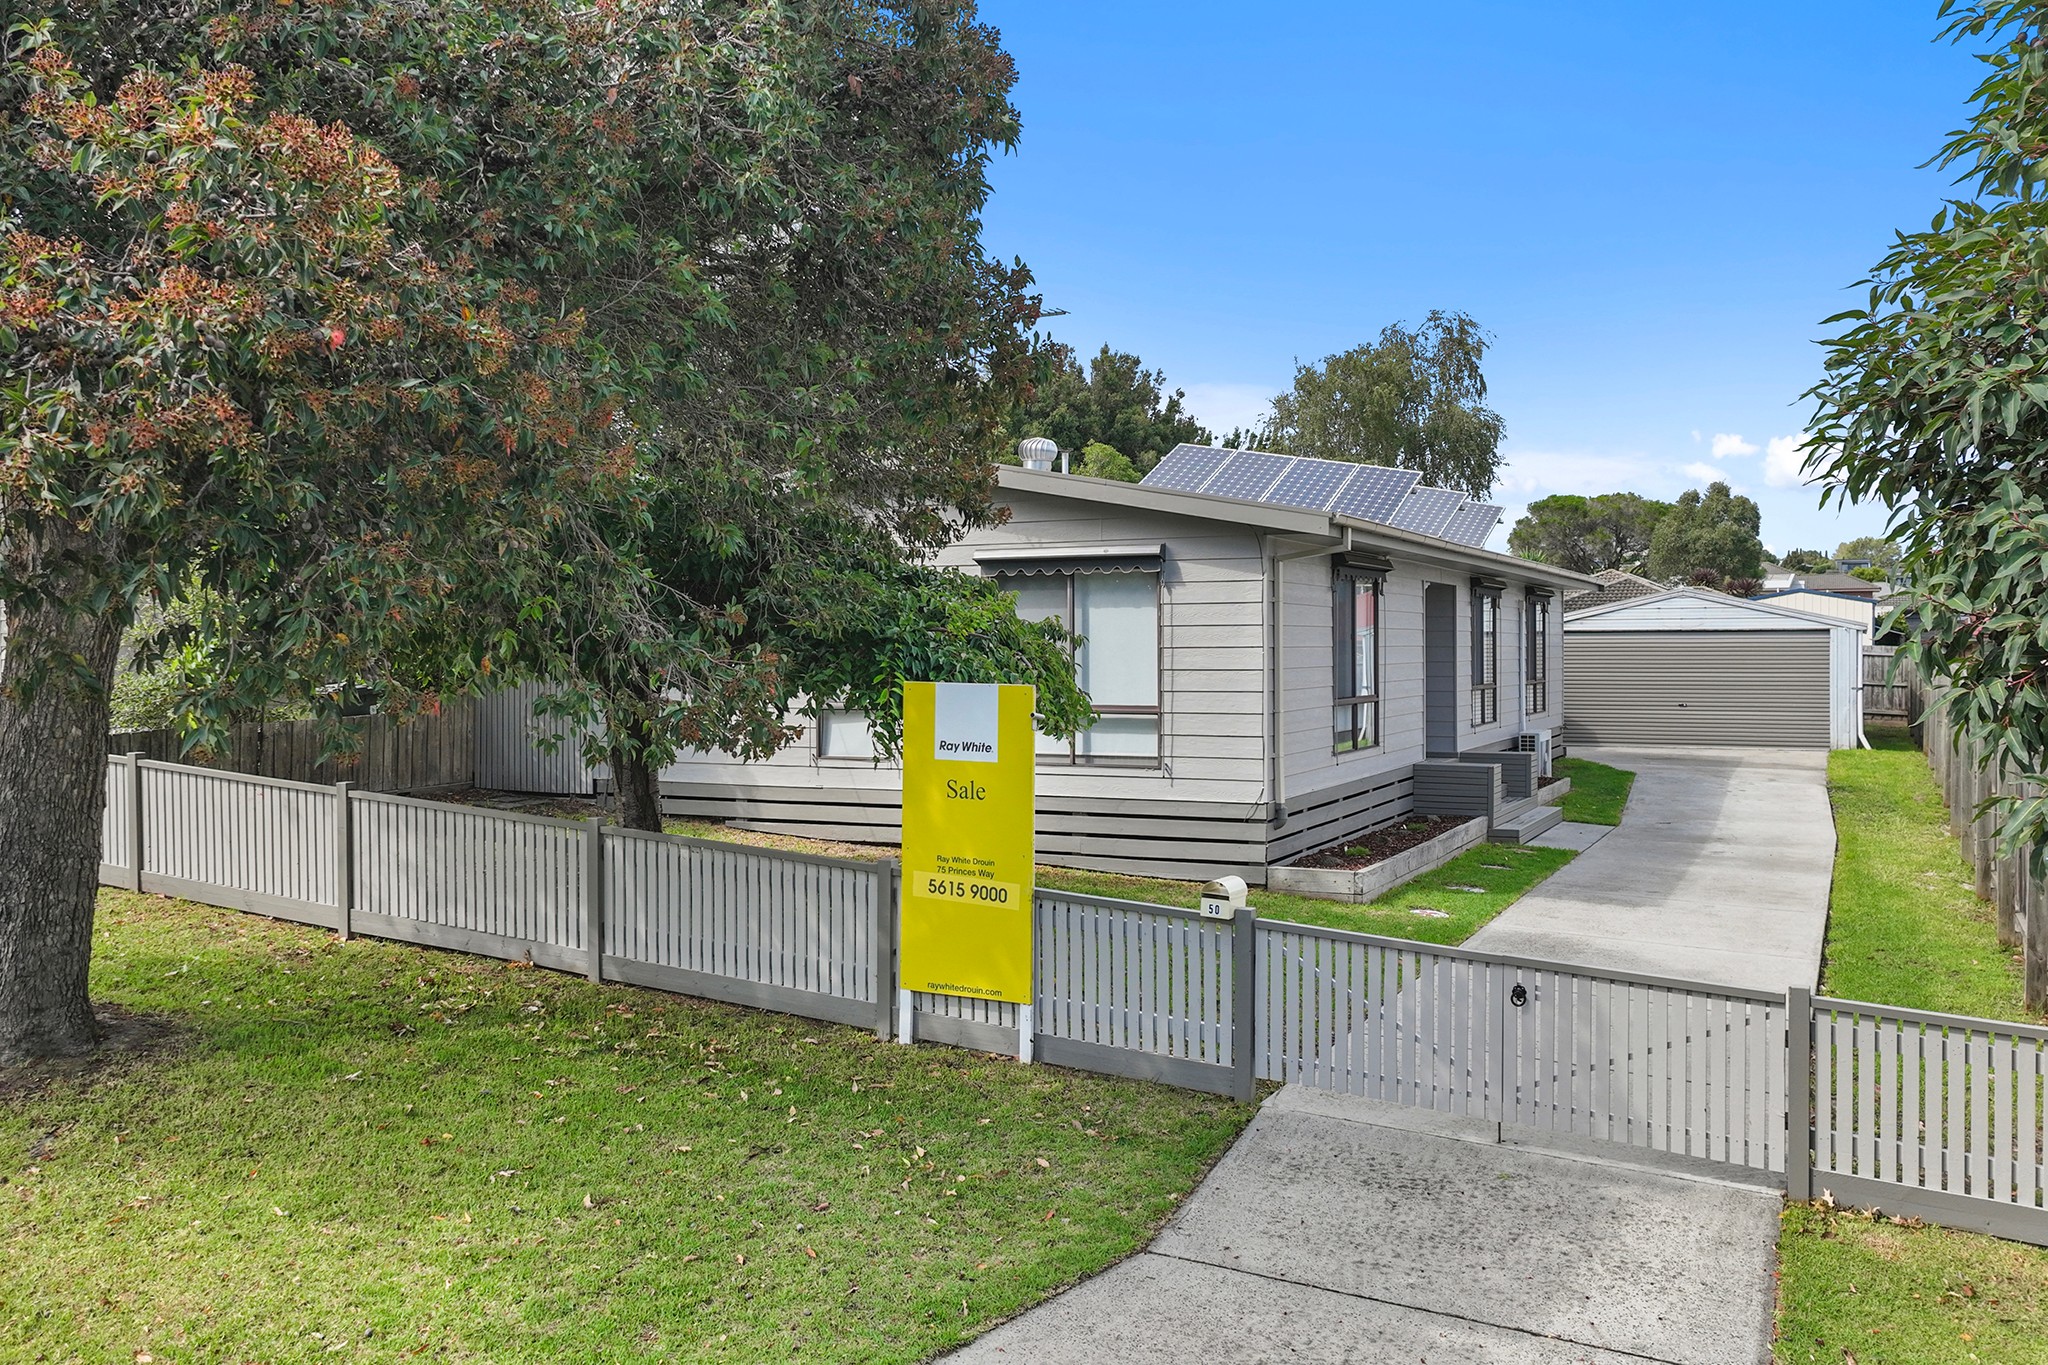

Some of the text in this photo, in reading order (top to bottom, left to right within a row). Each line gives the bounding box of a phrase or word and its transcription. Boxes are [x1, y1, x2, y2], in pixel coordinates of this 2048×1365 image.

[939, 740, 960, 753] Ray
[947, 779, 986, 800] Sale
[936, 855, 995, 867] Ray White Drouin
[937, 866, 995, 879] 75 Princes Way
[928, 878, 1008, 903] 5615 9000
[1209, 904, 1220, 915] 50
[927, 982, 1003, 996] raywhitedrouin.com
